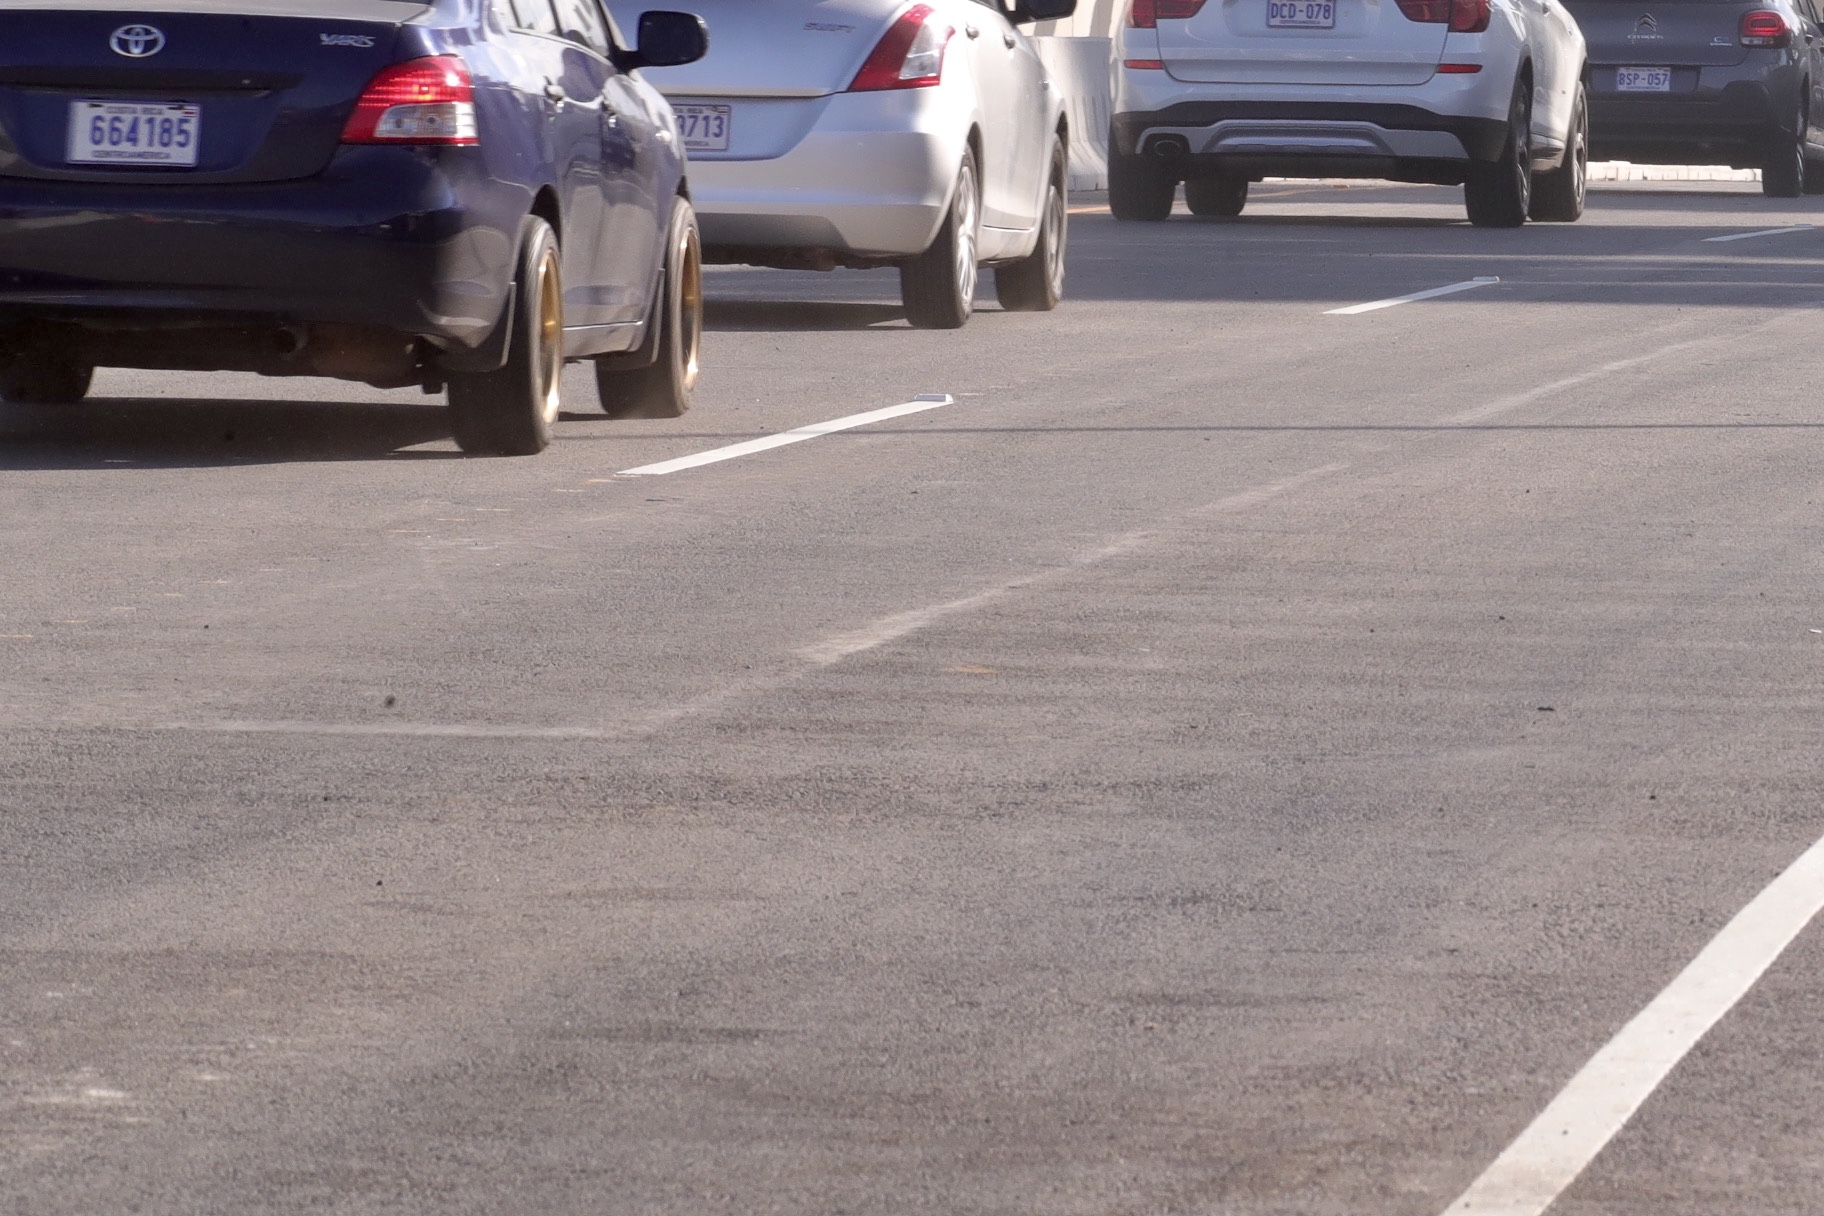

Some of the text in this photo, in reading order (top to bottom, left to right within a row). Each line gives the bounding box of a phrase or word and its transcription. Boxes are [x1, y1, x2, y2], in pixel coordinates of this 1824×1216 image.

[1270, 3, 1331, 20] DCD-078
[319, 33, 376, 48] YARIS
[90, 115, 191, 148] 664185
